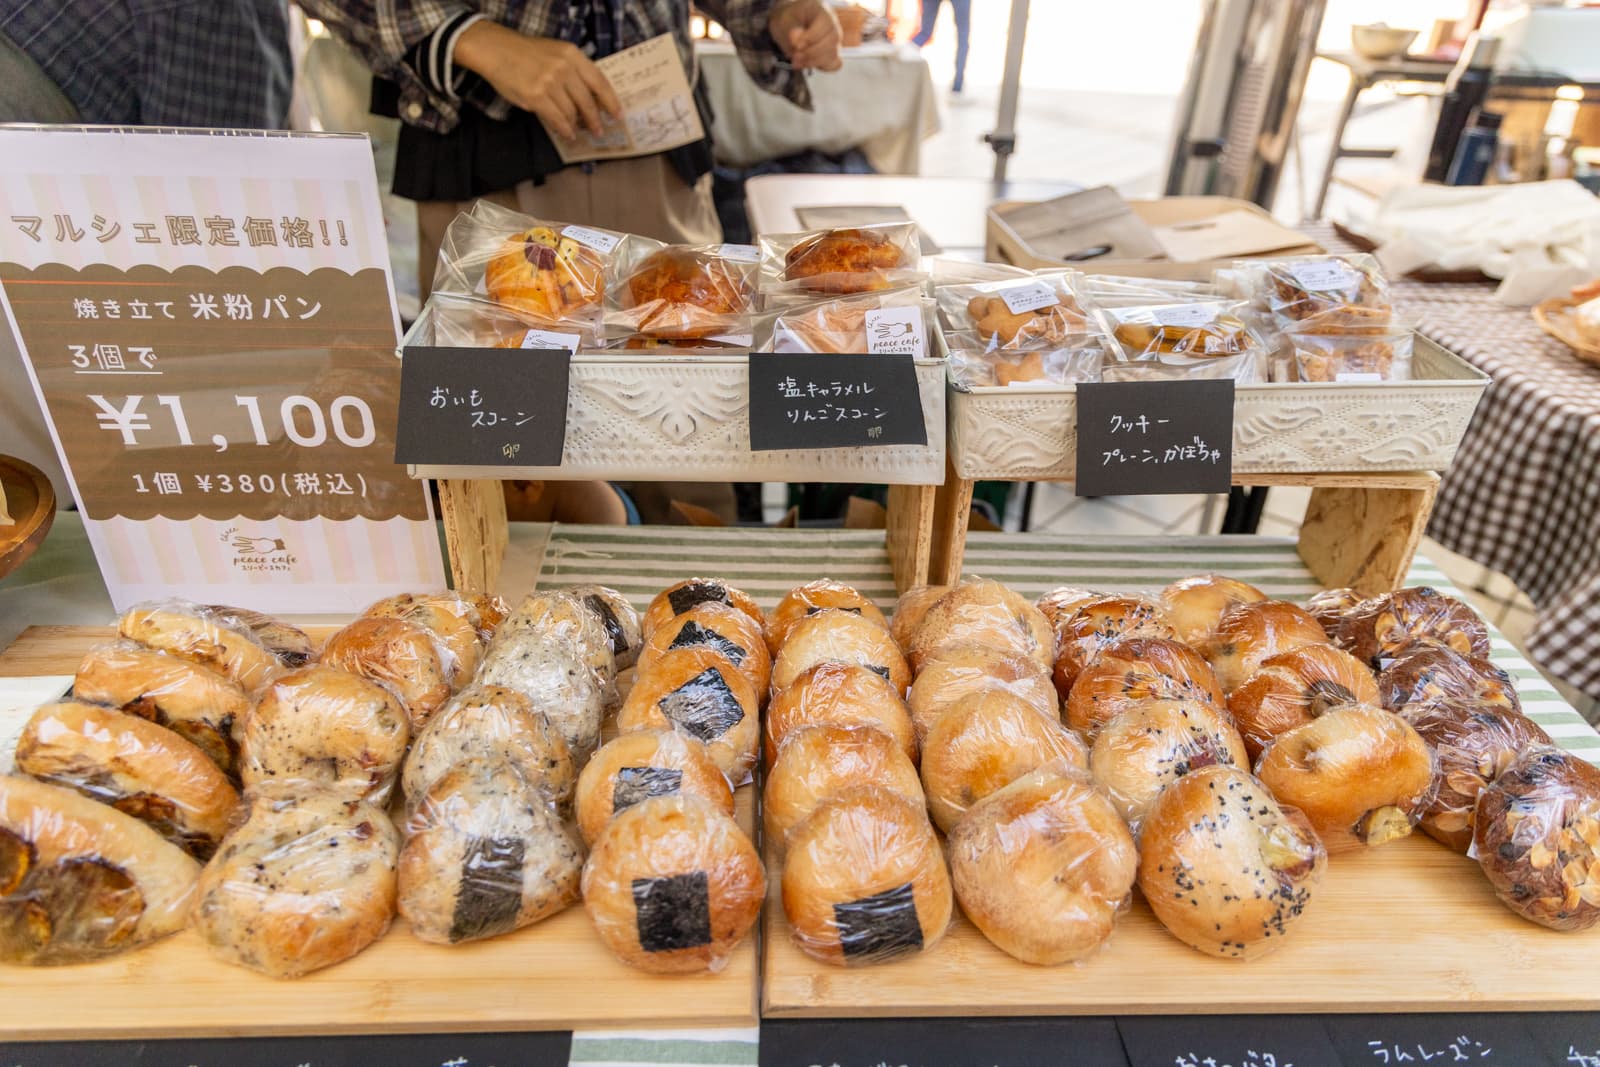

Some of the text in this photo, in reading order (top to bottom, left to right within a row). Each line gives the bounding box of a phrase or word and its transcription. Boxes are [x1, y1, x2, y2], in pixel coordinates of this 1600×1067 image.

[10, 213, 349, 248] マルシェ限定価格!!
[74, 293, 323, 320] 焼き立て 米粉パン
[67, 343, 158, 370] 3個で
[430, 386, 483, 409] おいも
[778, 376, 875, 398] 塩キャラメル
[86, 394, 376, 453] ¥1,100
[471, 411, 535, 428] スコーン
[787, 404, 889, 424] りんごスコーン
[1110, 414, 1170, 434] クッキー
[132, 472, 368, 497] 1個 ¥380(税込)
[233, 556, 267, 566] peace
[1368, 1035, 1491, 1063] ラムレーズン
